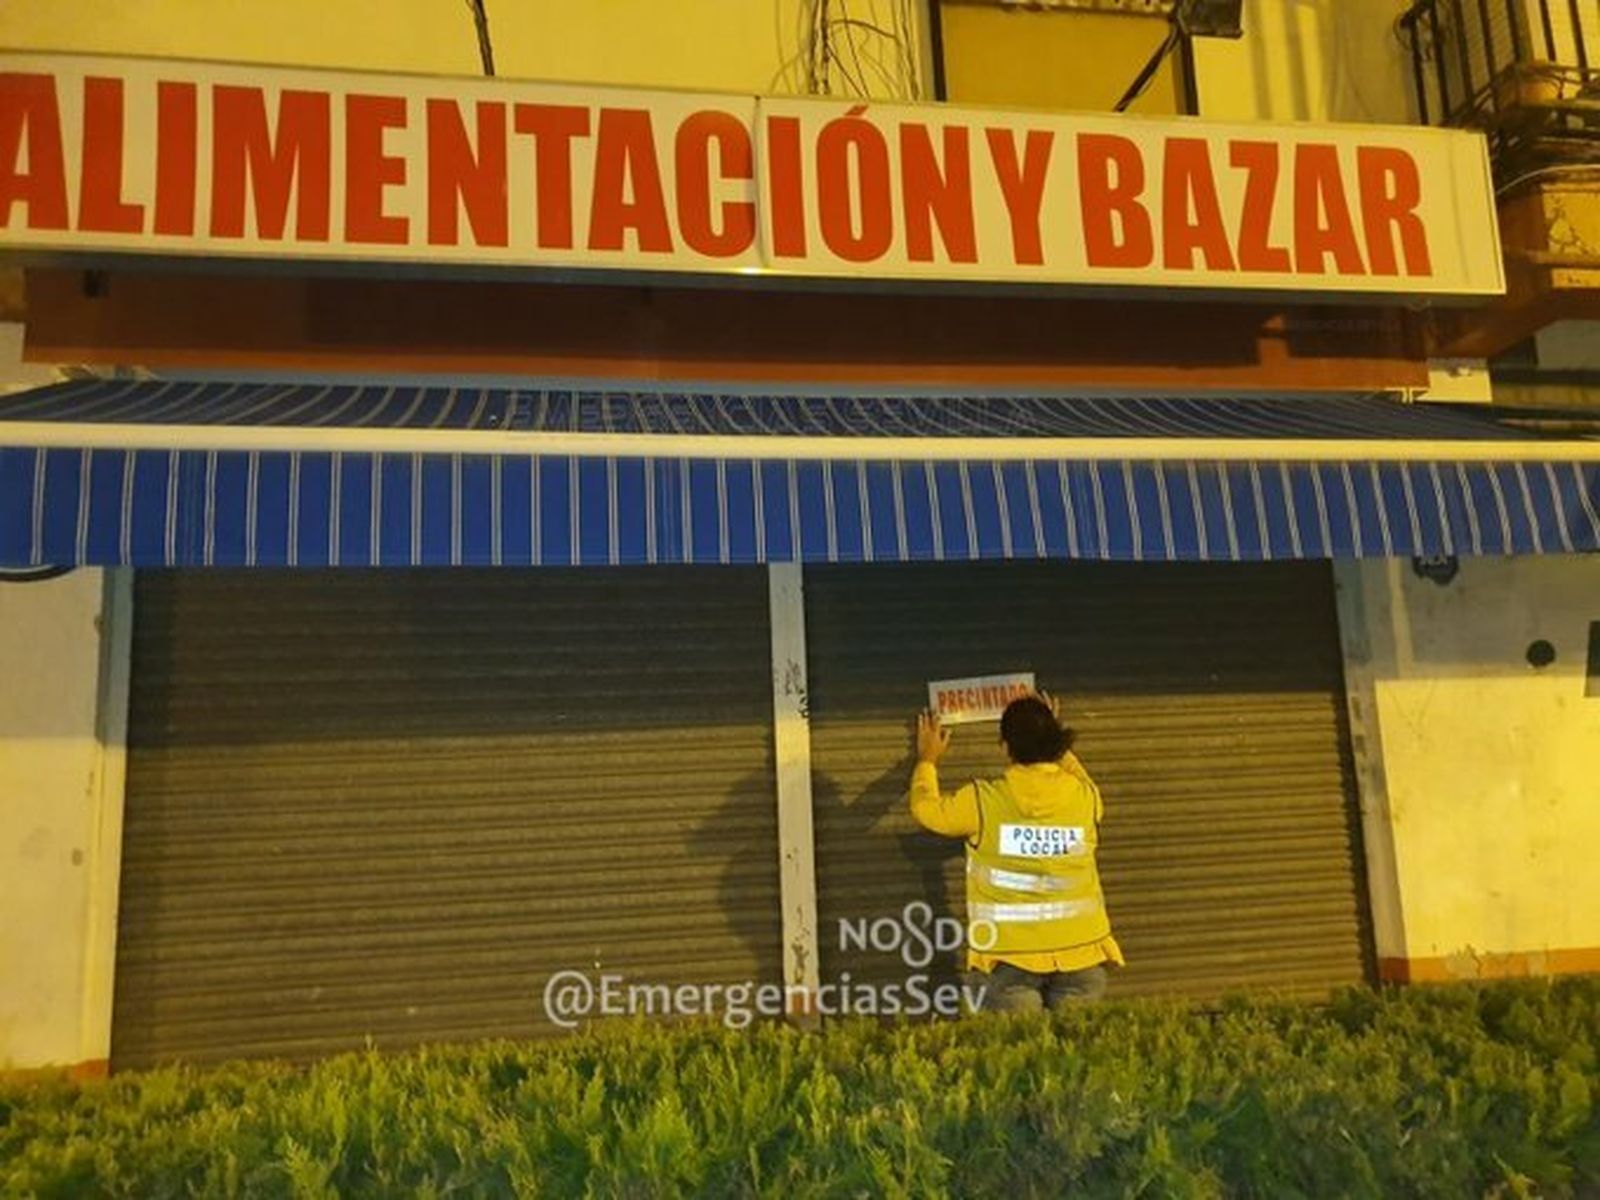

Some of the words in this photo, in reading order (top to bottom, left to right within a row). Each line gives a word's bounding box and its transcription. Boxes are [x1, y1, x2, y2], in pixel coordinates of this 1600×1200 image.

[0, 74, 978, 264] ALIMENTACIÓN
[985, 129, 1053, 265] Y
[1076, 133, 1431, 277] BAZAR
[1013, 827, 1076, 841] POLICIA
[1020, 842, 1069, 855] LOCAL
